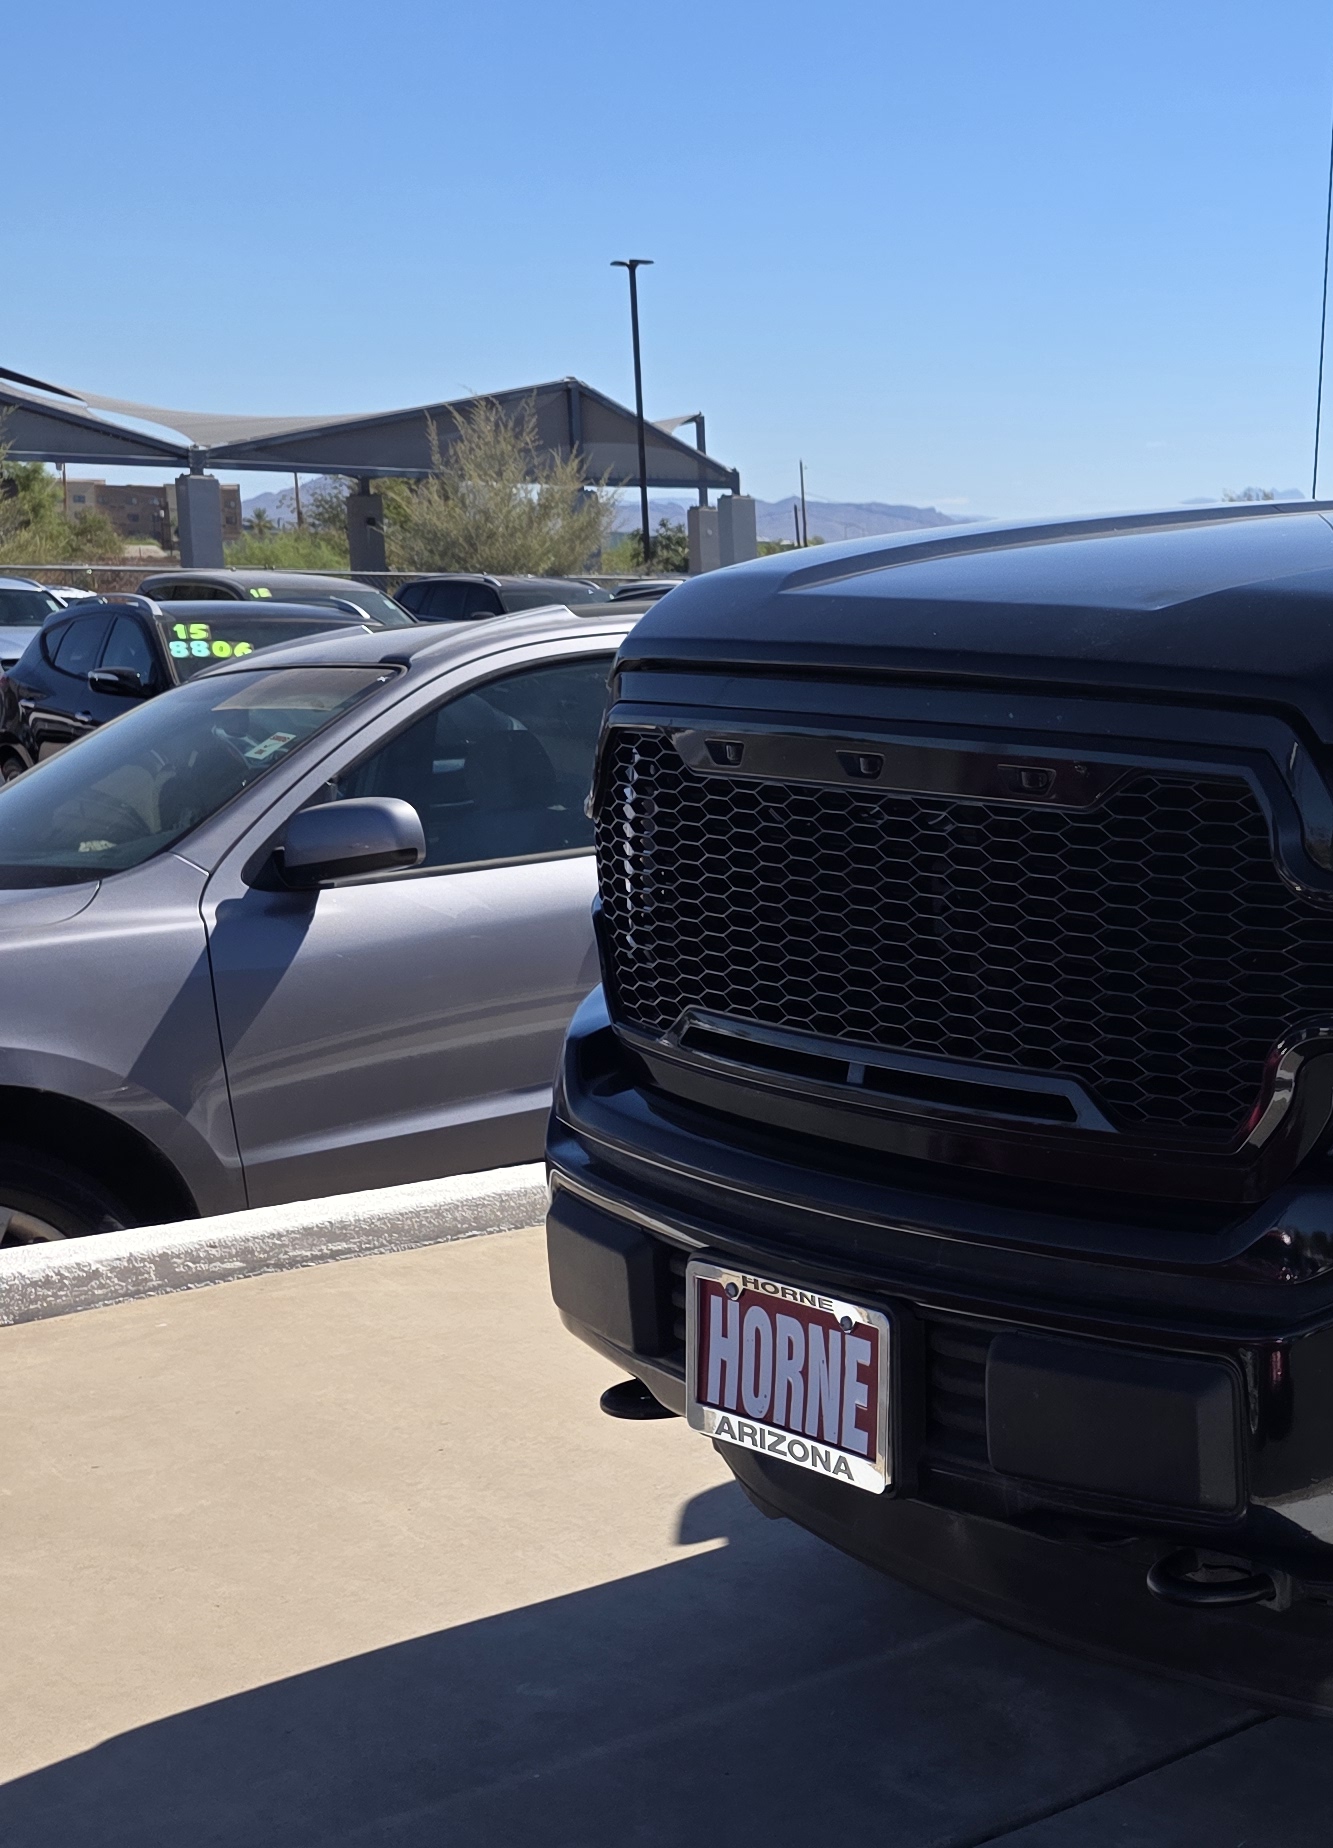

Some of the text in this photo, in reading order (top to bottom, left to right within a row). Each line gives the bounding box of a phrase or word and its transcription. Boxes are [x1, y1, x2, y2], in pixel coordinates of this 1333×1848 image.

[168, 640, 254, 658] 8806
[173, 623, 210, 640] 15
[741, 1275, 834, 1312] HORNE
[706, 1294, 872, 1456] HORNE
[714, 1416, 855, 1481] ARIZONA
